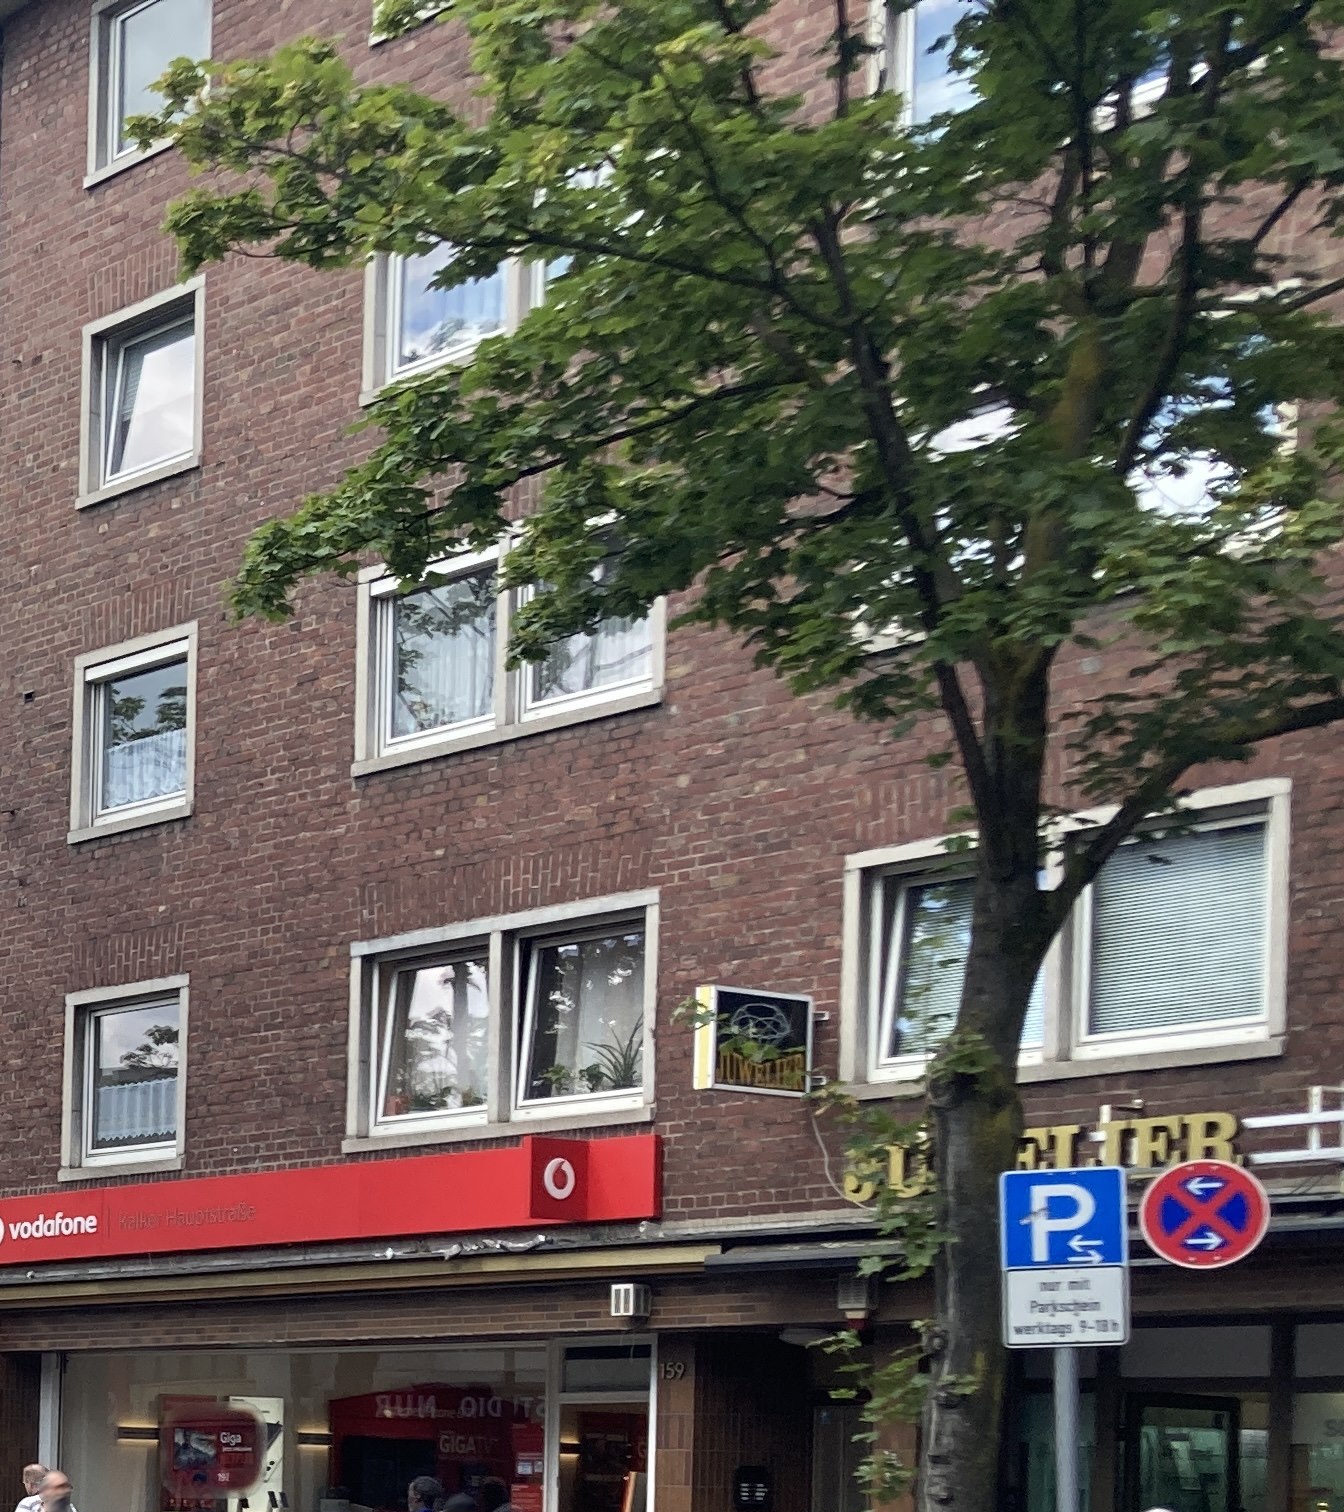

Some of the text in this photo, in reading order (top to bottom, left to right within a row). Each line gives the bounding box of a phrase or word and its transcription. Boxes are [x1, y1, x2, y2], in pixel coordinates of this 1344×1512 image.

[843, 1112, 1244, 1201] UELIER
[8, 1211, 98, 1240] vodafone
[1030, 1301, 1101, 1318] Parkschein
[659, 1362, 686, 1380] 159
[220, 1431, 242, 1456] Giga
